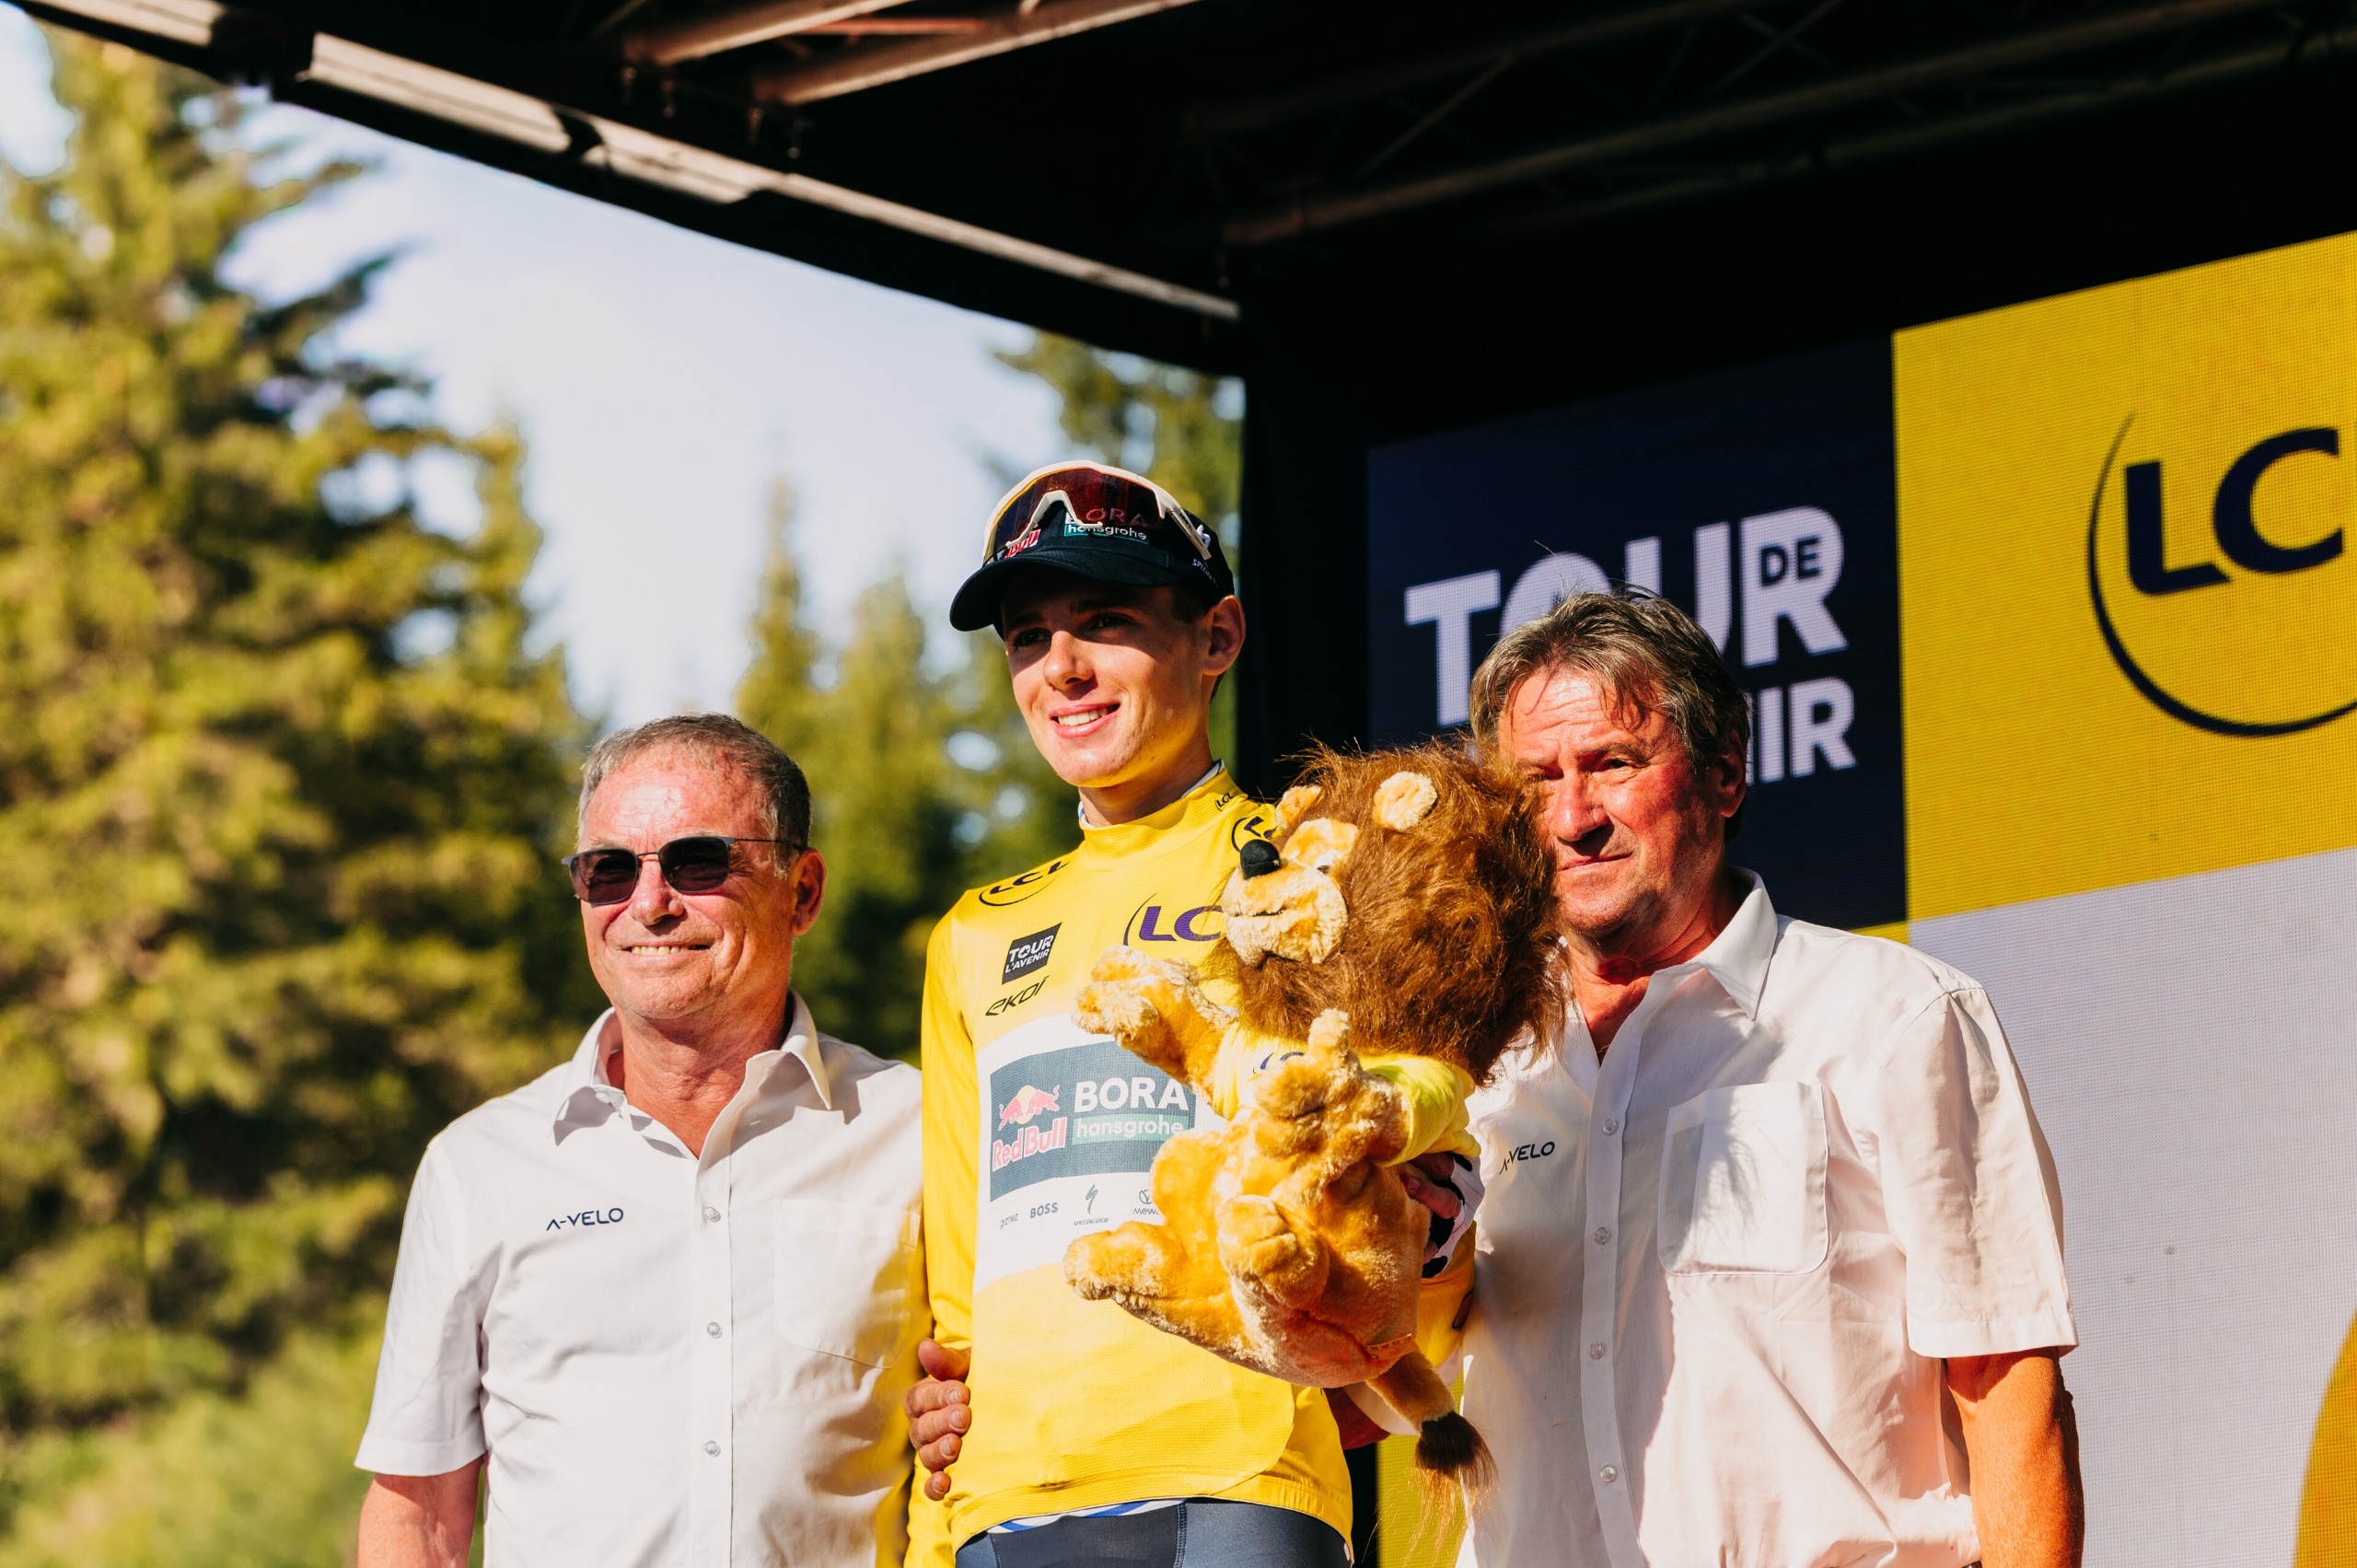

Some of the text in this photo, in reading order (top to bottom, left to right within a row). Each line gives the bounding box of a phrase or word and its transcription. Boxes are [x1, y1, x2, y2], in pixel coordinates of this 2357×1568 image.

[2125, 427, 2346, 597] LC
[1760, 538, 1820, 585] DE
[989, 860, 1069, 895] LCL
[1139, 905, 1225, 941] LC
[1004, 948, 1050, 973] L'AVENIR
[1009, 935, 1054, 963] TOUR
[1074, 1076, 1190, 1112] BORA
[993, 1117, 1067, 1172] Red Bull
[1075, 1116, 1185, 1139] hansgrohe
[1498, 1141, 1556, 1175] A-VELO
[546, 1207, 624, 1231] A-VELO
[1030, 1202, 1059, 1219] BOSS
